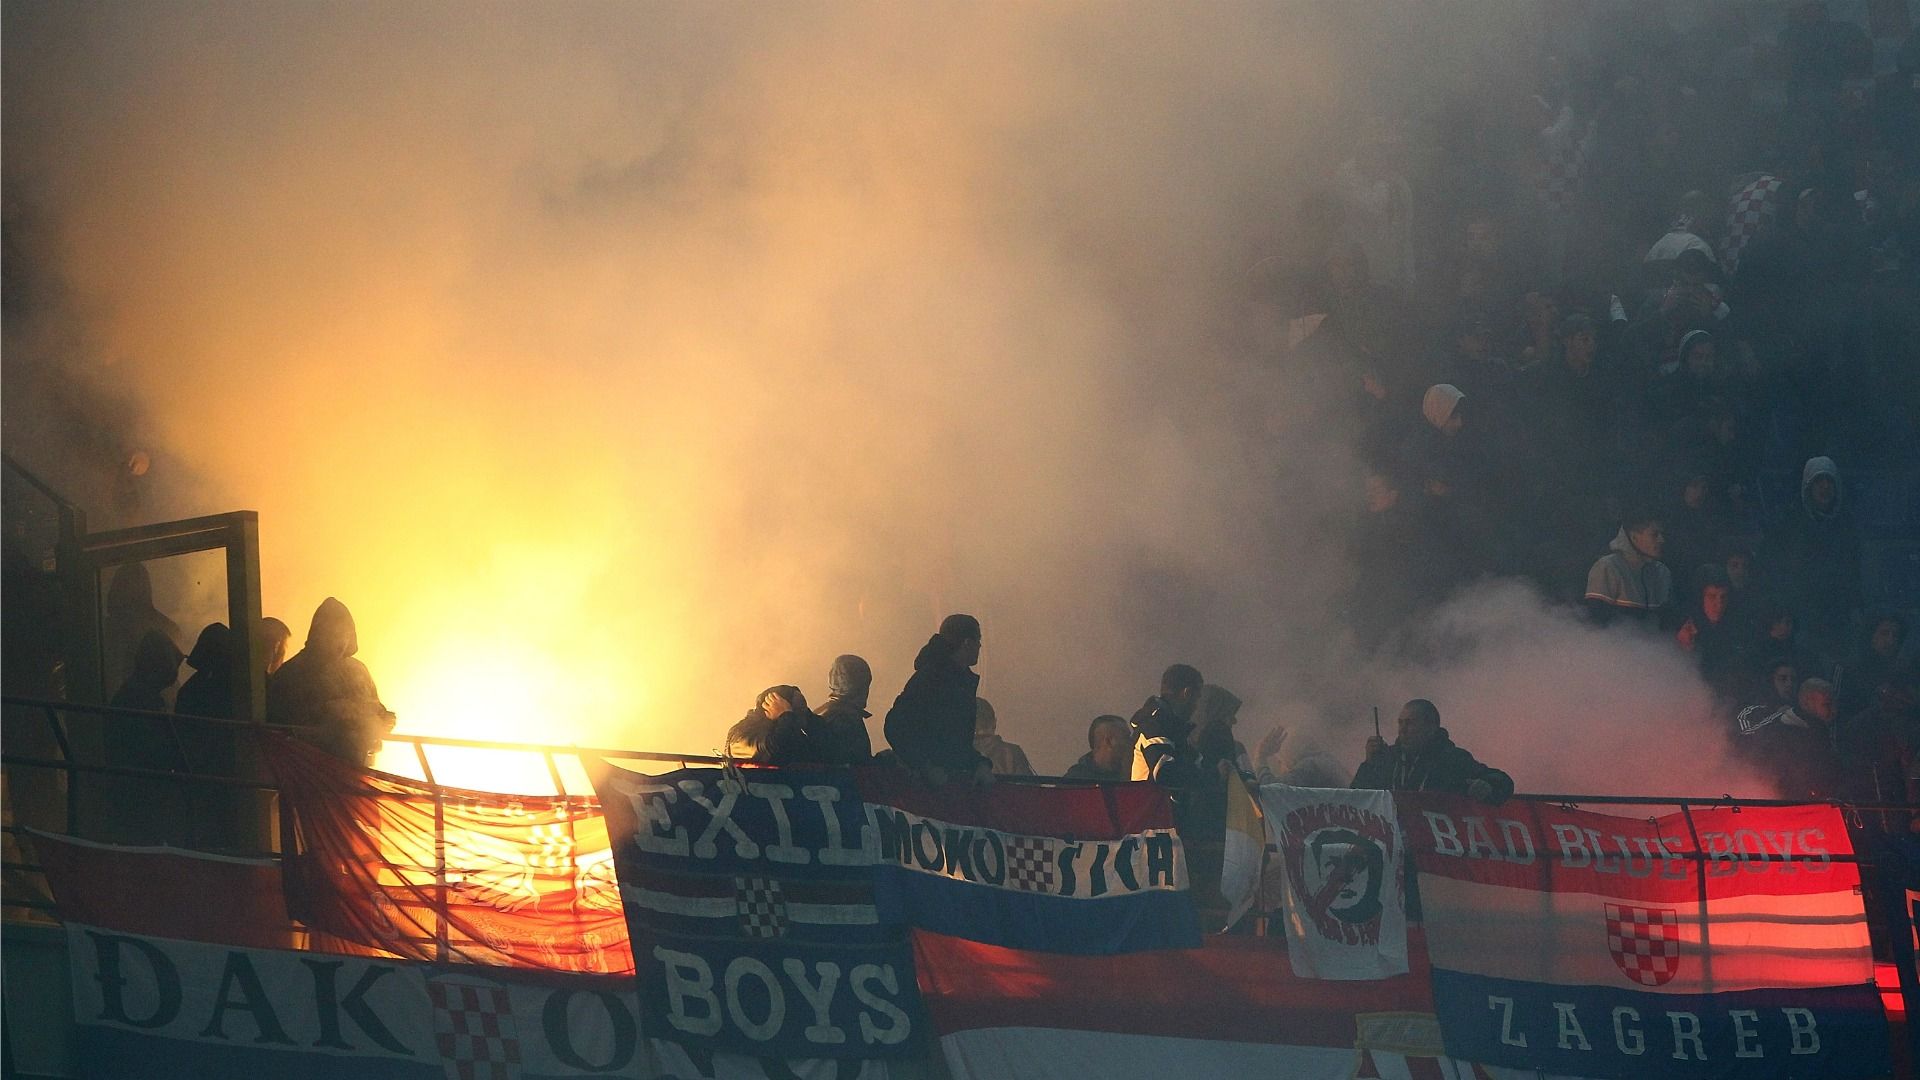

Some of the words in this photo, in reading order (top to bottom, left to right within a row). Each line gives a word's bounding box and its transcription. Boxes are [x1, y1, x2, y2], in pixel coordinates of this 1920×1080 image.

[609, 778, 878, 866] EXIL
[1422, 810, 1536, 866] BAD
[1551, 823, 1688, 881] BLUE
[1703, 828, 1831, 878] BOYS
[652, 944, 911, 1044] BOYS
[1488, 995, 1822, 1061] ZAGREB
